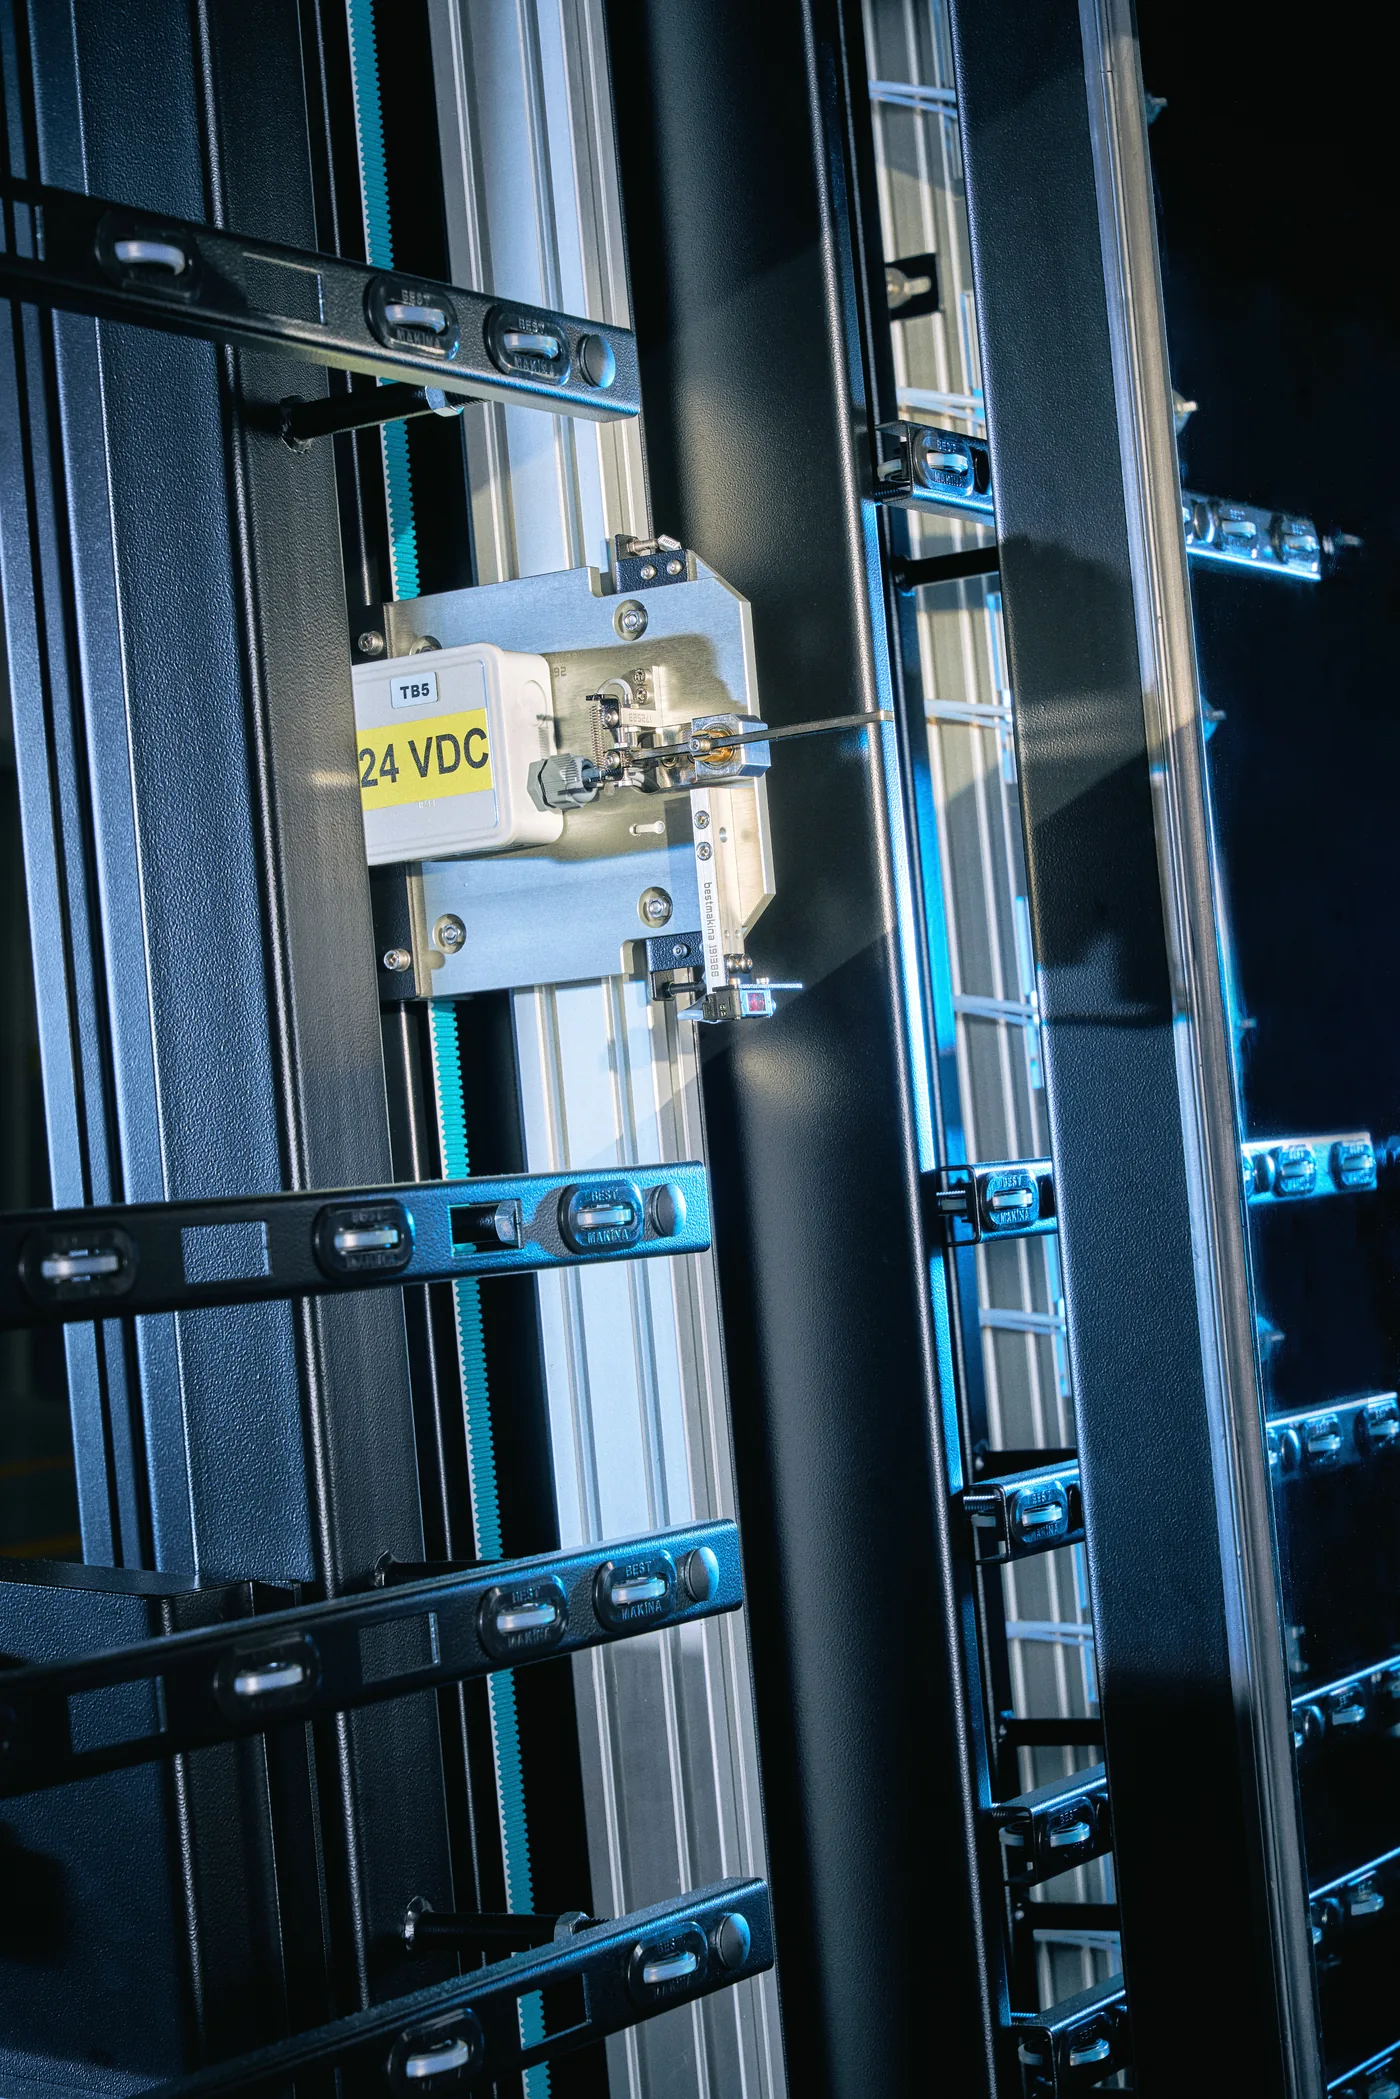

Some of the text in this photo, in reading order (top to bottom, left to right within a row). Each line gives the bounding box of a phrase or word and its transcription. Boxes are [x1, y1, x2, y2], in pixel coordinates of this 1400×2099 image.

[400, 683, 430, 699] TB5
[359, 727, 489, 788] 24 VDC
[703, 881, 720, 978] bestmakina 191388
[591, 1187, 618, 1202] BEST
[625, 1560, 652, 1578] BEST
